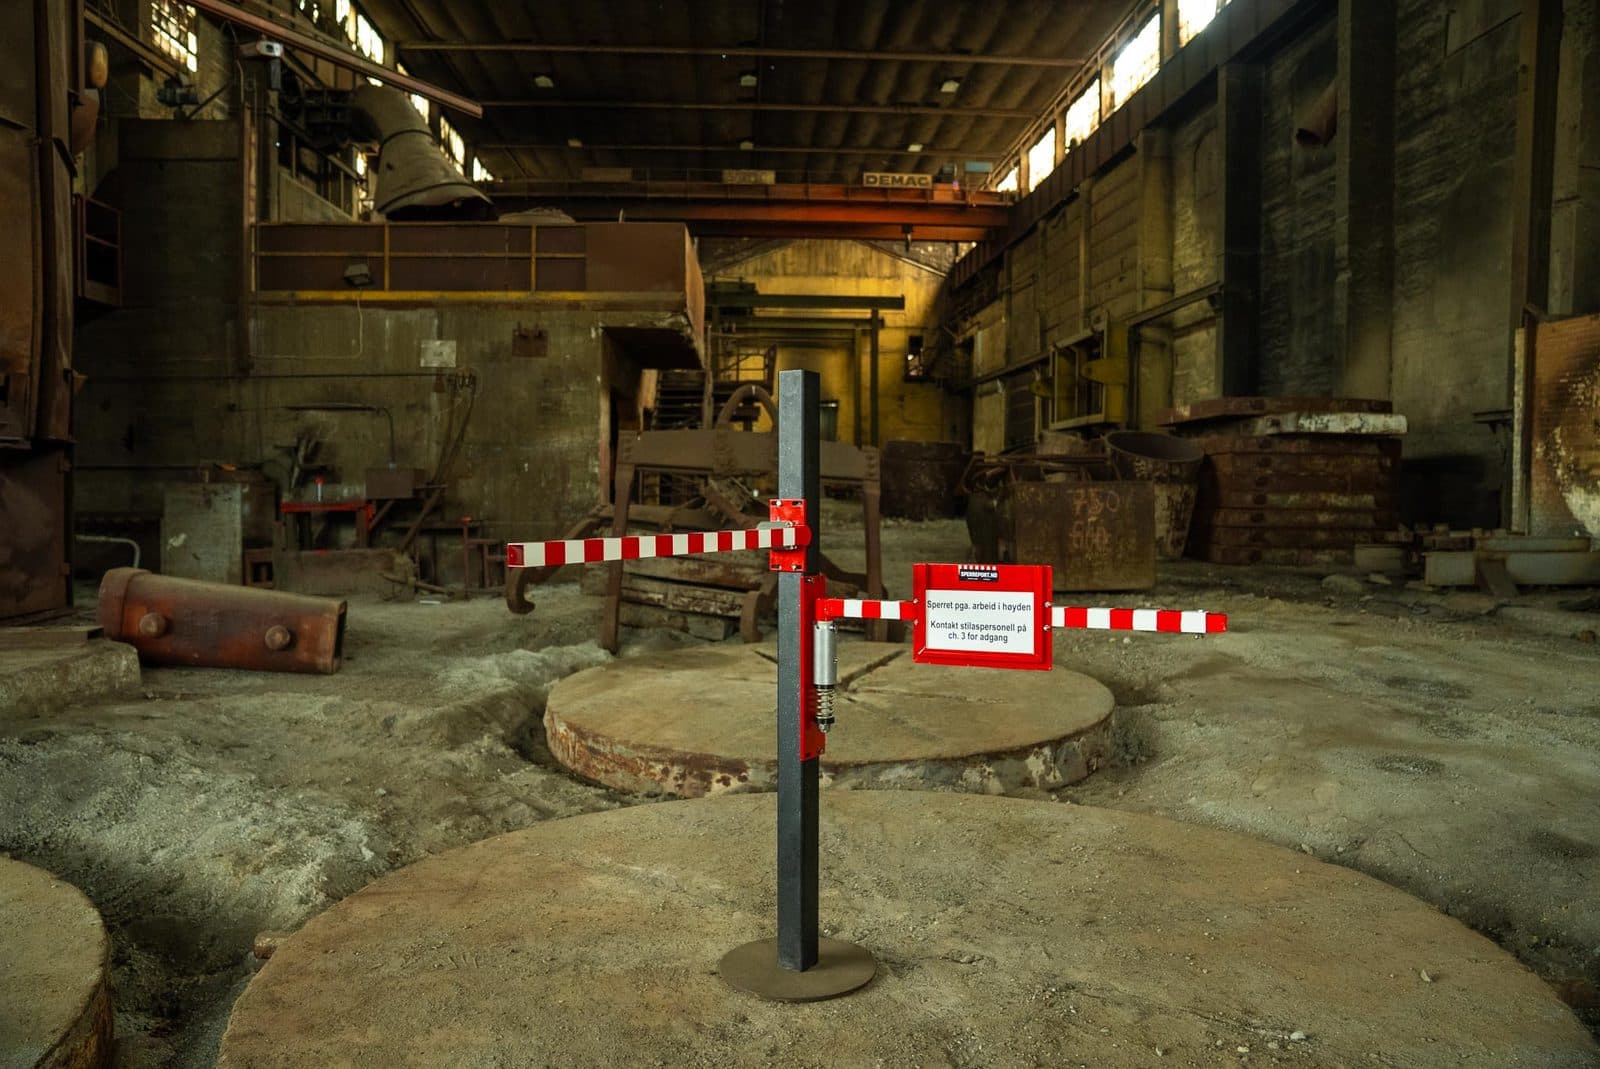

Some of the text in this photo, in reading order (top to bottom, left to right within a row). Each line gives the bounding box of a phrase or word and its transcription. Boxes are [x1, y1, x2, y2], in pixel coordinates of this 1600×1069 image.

[927, 600, 953, 610] Sperret
[955, 602, 971, 611] pga.
[972, 602, 996, 611] arbeid
[1003, 602, 1032, 612] høyden
[930, 620, 1027, 634] Kontakt stilaspersonell på
[948, 631, 1008, 644] ch. 3 for adgang
